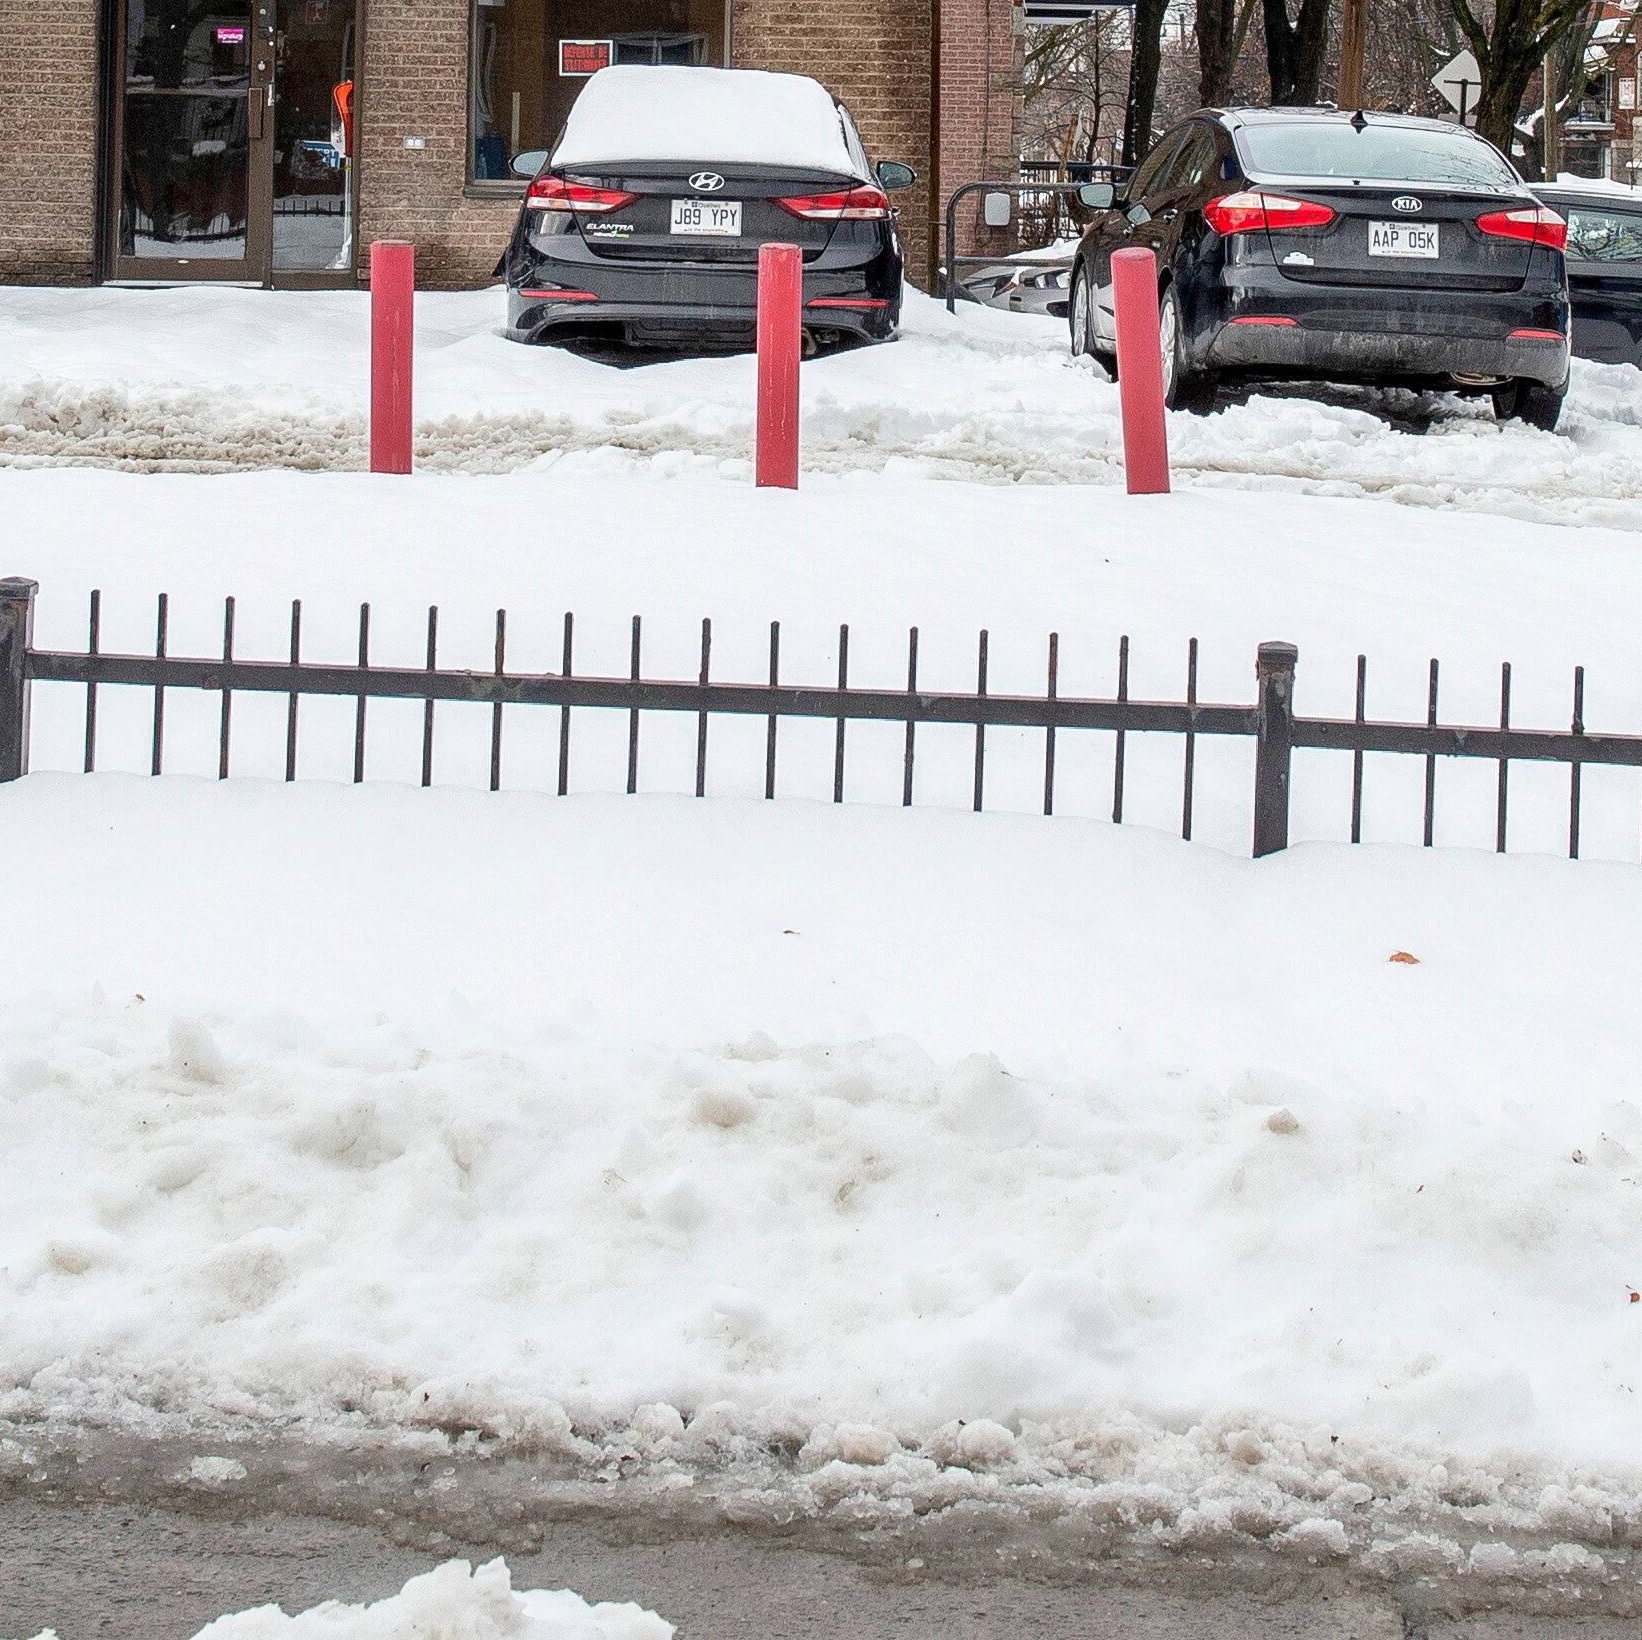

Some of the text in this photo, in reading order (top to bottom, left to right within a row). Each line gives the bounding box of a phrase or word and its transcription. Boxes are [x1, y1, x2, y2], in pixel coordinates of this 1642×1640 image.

[1397, 199, 1418, 209] KIA
[674, 208, 737, 227] J89 YPY
[586, 223, 634, 232] ELANTRA
[1373, 229, 1399, 248] AAP
